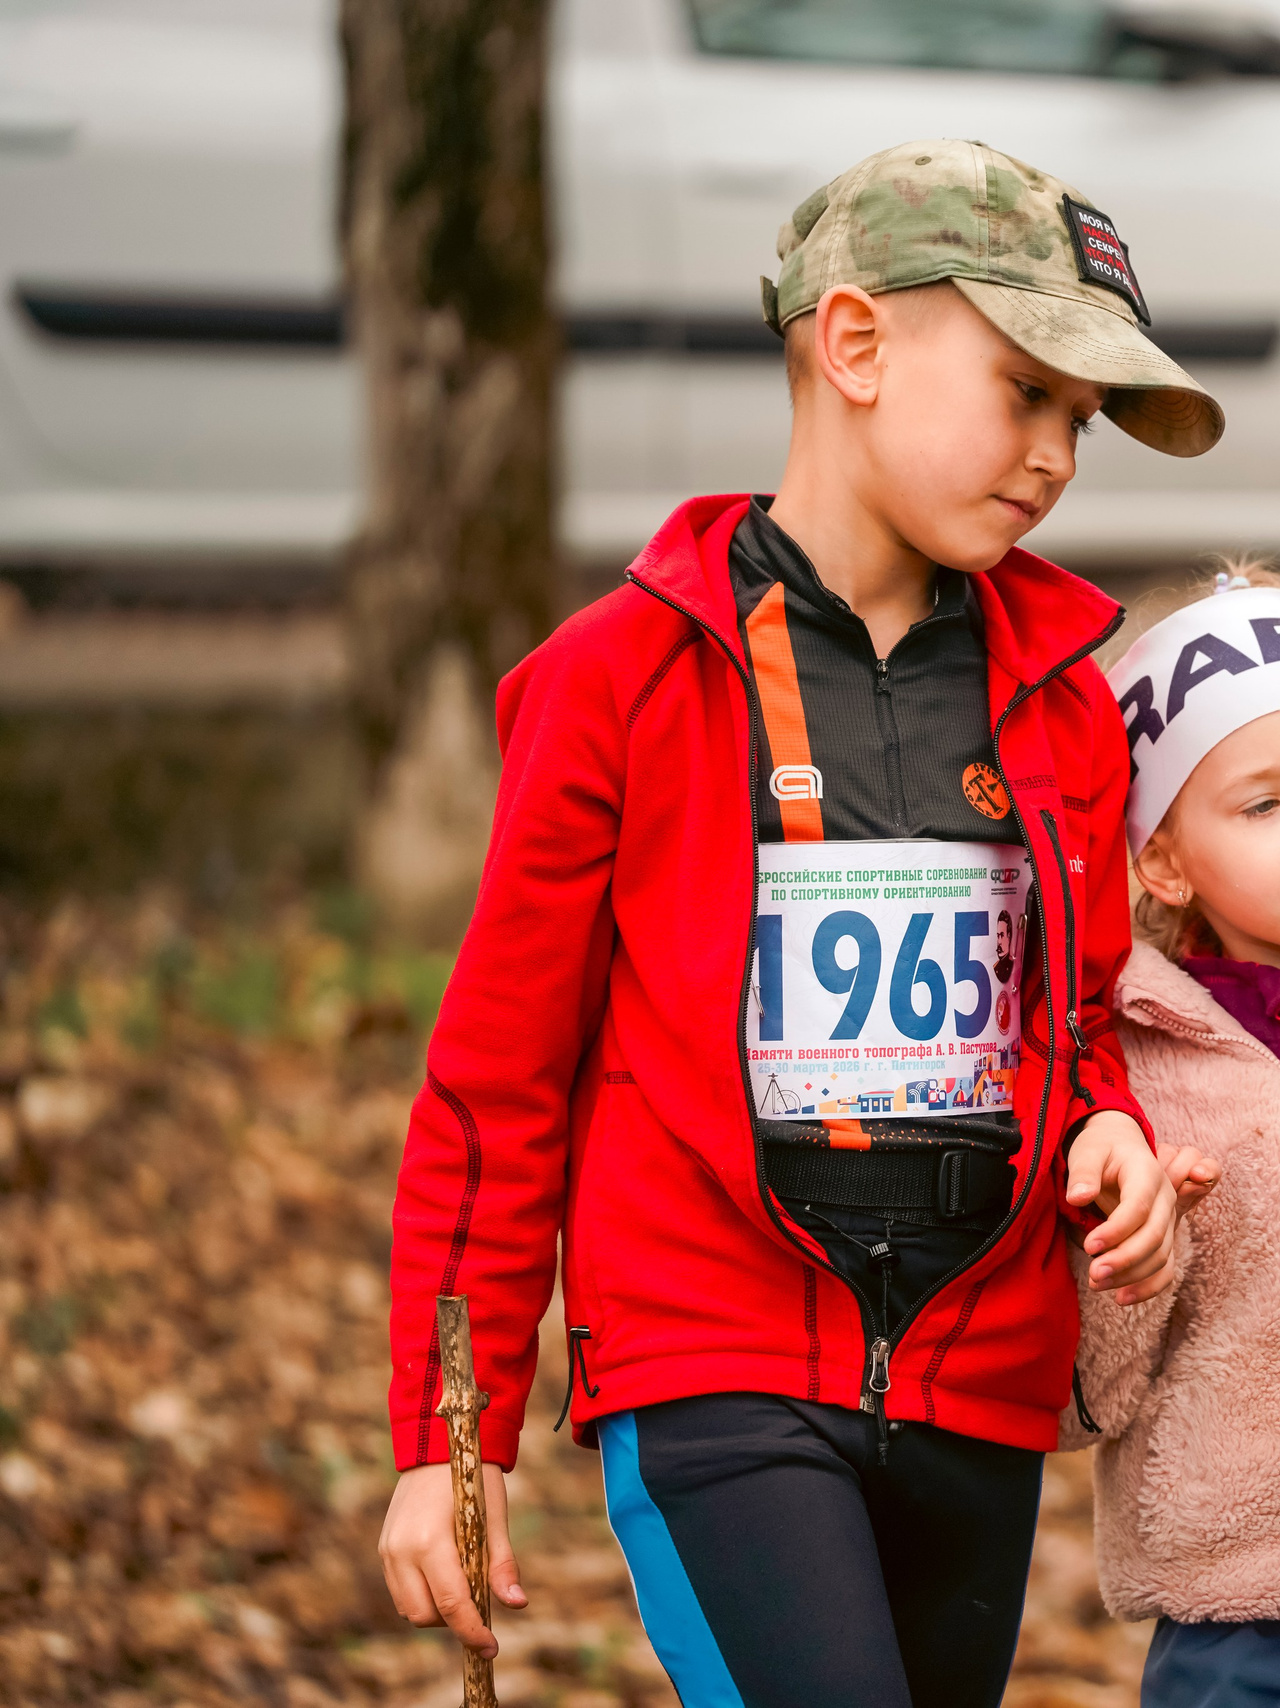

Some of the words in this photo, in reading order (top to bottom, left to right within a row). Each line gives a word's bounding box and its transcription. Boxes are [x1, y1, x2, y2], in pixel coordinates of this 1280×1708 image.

[1079, 212, 1103, 230] МОЯ
[1082, 224, 1121, 252] НАСТО
[1084, 245, 1105, 262] ЧТО
[1106, 255, 1115, 267] Я
[1088, 237, 1124, 265] СЕКРЕ
[1090, 258, 1112, 276] ЧТО
[1113, 268, 1122, 280] Я
[758, 869, 842, 884] ЕРОССИЙСКИЕ
[846, 869, 923, 882] СПОРТИВНЫЕ
[926, 868, 988, 881] СОРЕВНОВАНИЯ
[771, 889, 786, 901] ПО
[791, 887, 879, 901] СПОРТИВНОМУ
[883, 885, 971, 900] ОРИЕНТИРОВАНИЮ
[754, 909, 992, 1042] 1965
[798, 1047, 860, 1059] военного
[864, 1043, 932, 1061] топографа
[936, 1043, 945, 1056] А.
[948, 1042, 957, 1056] В.
[960, 1041, 998, 1057] Пастухова
[757, 1062, 789, 1074] 25-30
[793, 1063, 829, 1075] марта
[833, 1061, 860, 1073] 2026
[863, 1062, 874, 1072] г.
[877, 1061, 888, 1071] г.
[891, 1059, 946, 1072] Пятигорск
